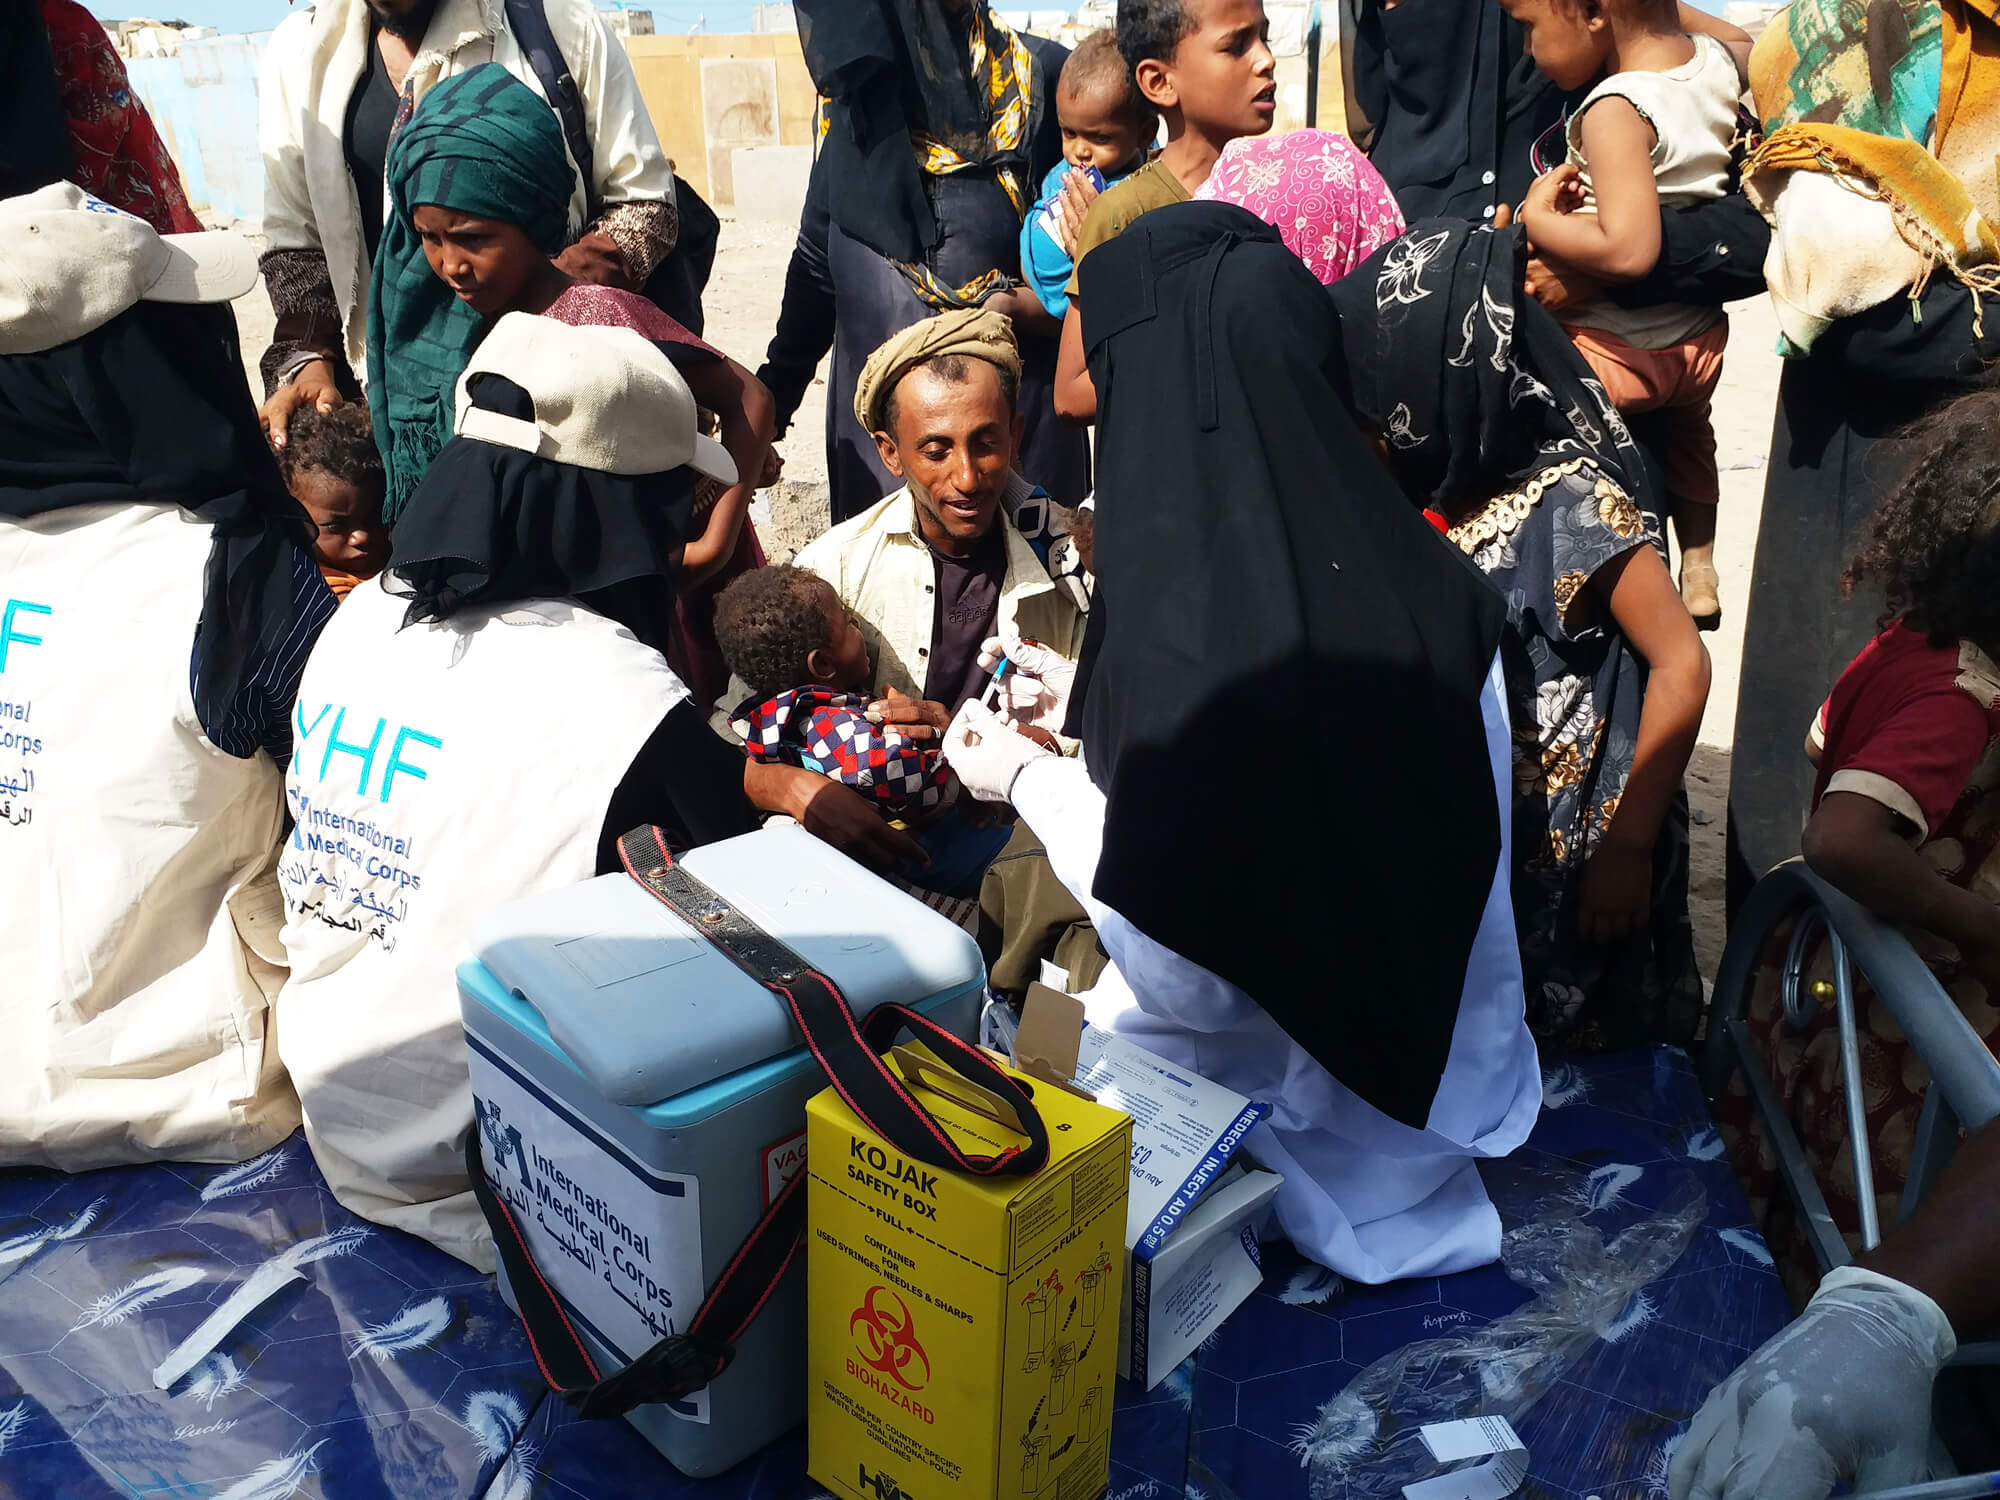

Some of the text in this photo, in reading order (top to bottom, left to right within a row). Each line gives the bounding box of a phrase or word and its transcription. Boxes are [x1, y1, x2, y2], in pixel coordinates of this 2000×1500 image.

[0, 700, 31, 723] nal
[295, 699, 444, 804] YHF
[307, 832, 364, 870] Medical
[308, 806, 413, 860] International
[366, 856, 421, 890] Corps
[1217, 1108, 1260, 1153] MEDECO
[774, 1142, 808, 1171] VAC
[850, 1135, 939, 1200] KOJAK
[1130, 1164, 1164, 1187] Abu Dha
[1131, 1145, 1153, 1165] 0.5
[847, 1164, 937, 1223] SAFETY BOX
[1182, 1157, 1220, 1199] INJECT
[531, 1143, 652, 1264] International
[876, 1207, 905, 1232] FULL
[1168, 1197, 1186, 1216] AD
[536, 1200, 596, 1276] الطبية
[536, 1177, 673, 1309] Medical Corps
[1060, 1225, 1083, 1249] FULL
[1152, 1215, 1175, 1237] 0.5
[864, 1234, 916, 1270] CONTAINER
[881, 1256, 900, 1273] FOR
[816, 1228, 974, 1325] USED SYRINGES, NEEDLES & SHARPS
[603, 1259, 675, 1338] الهيئة
[846, 1357, 935, 1425] BIOHAZARD
[824, 1380, 963, 1475] DISPOSE AS PER COUNTRY SPECIFIC
[825, 1391, 960, 1482] WASTE DISPOSAL NATIONAL POLICY
[866, 1428, 912, 1463] GUIDELINES
